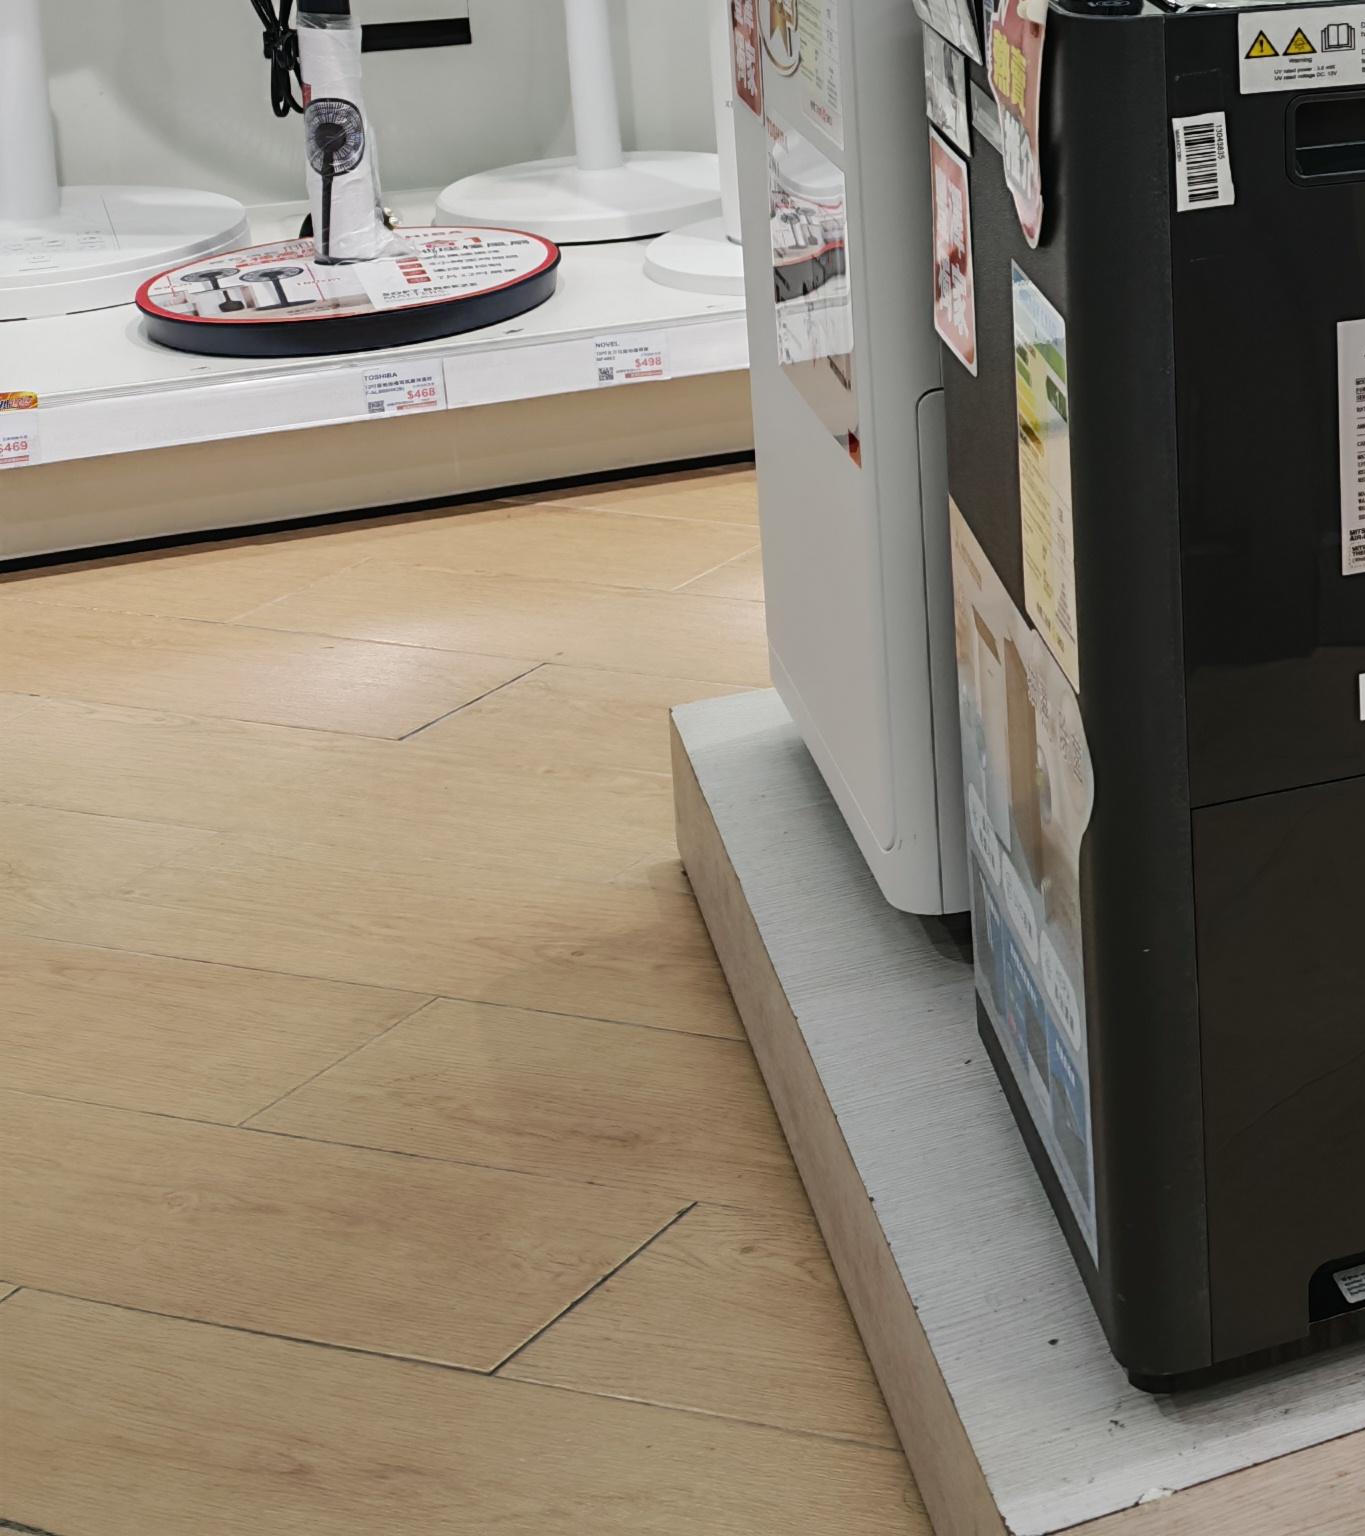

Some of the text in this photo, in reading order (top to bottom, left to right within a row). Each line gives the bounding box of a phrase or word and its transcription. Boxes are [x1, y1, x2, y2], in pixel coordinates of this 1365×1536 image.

[634, 357, 662, 369] $498
[364, 372, 398, 381] TOSHIBA
[407, 387, 436, 399] $468
